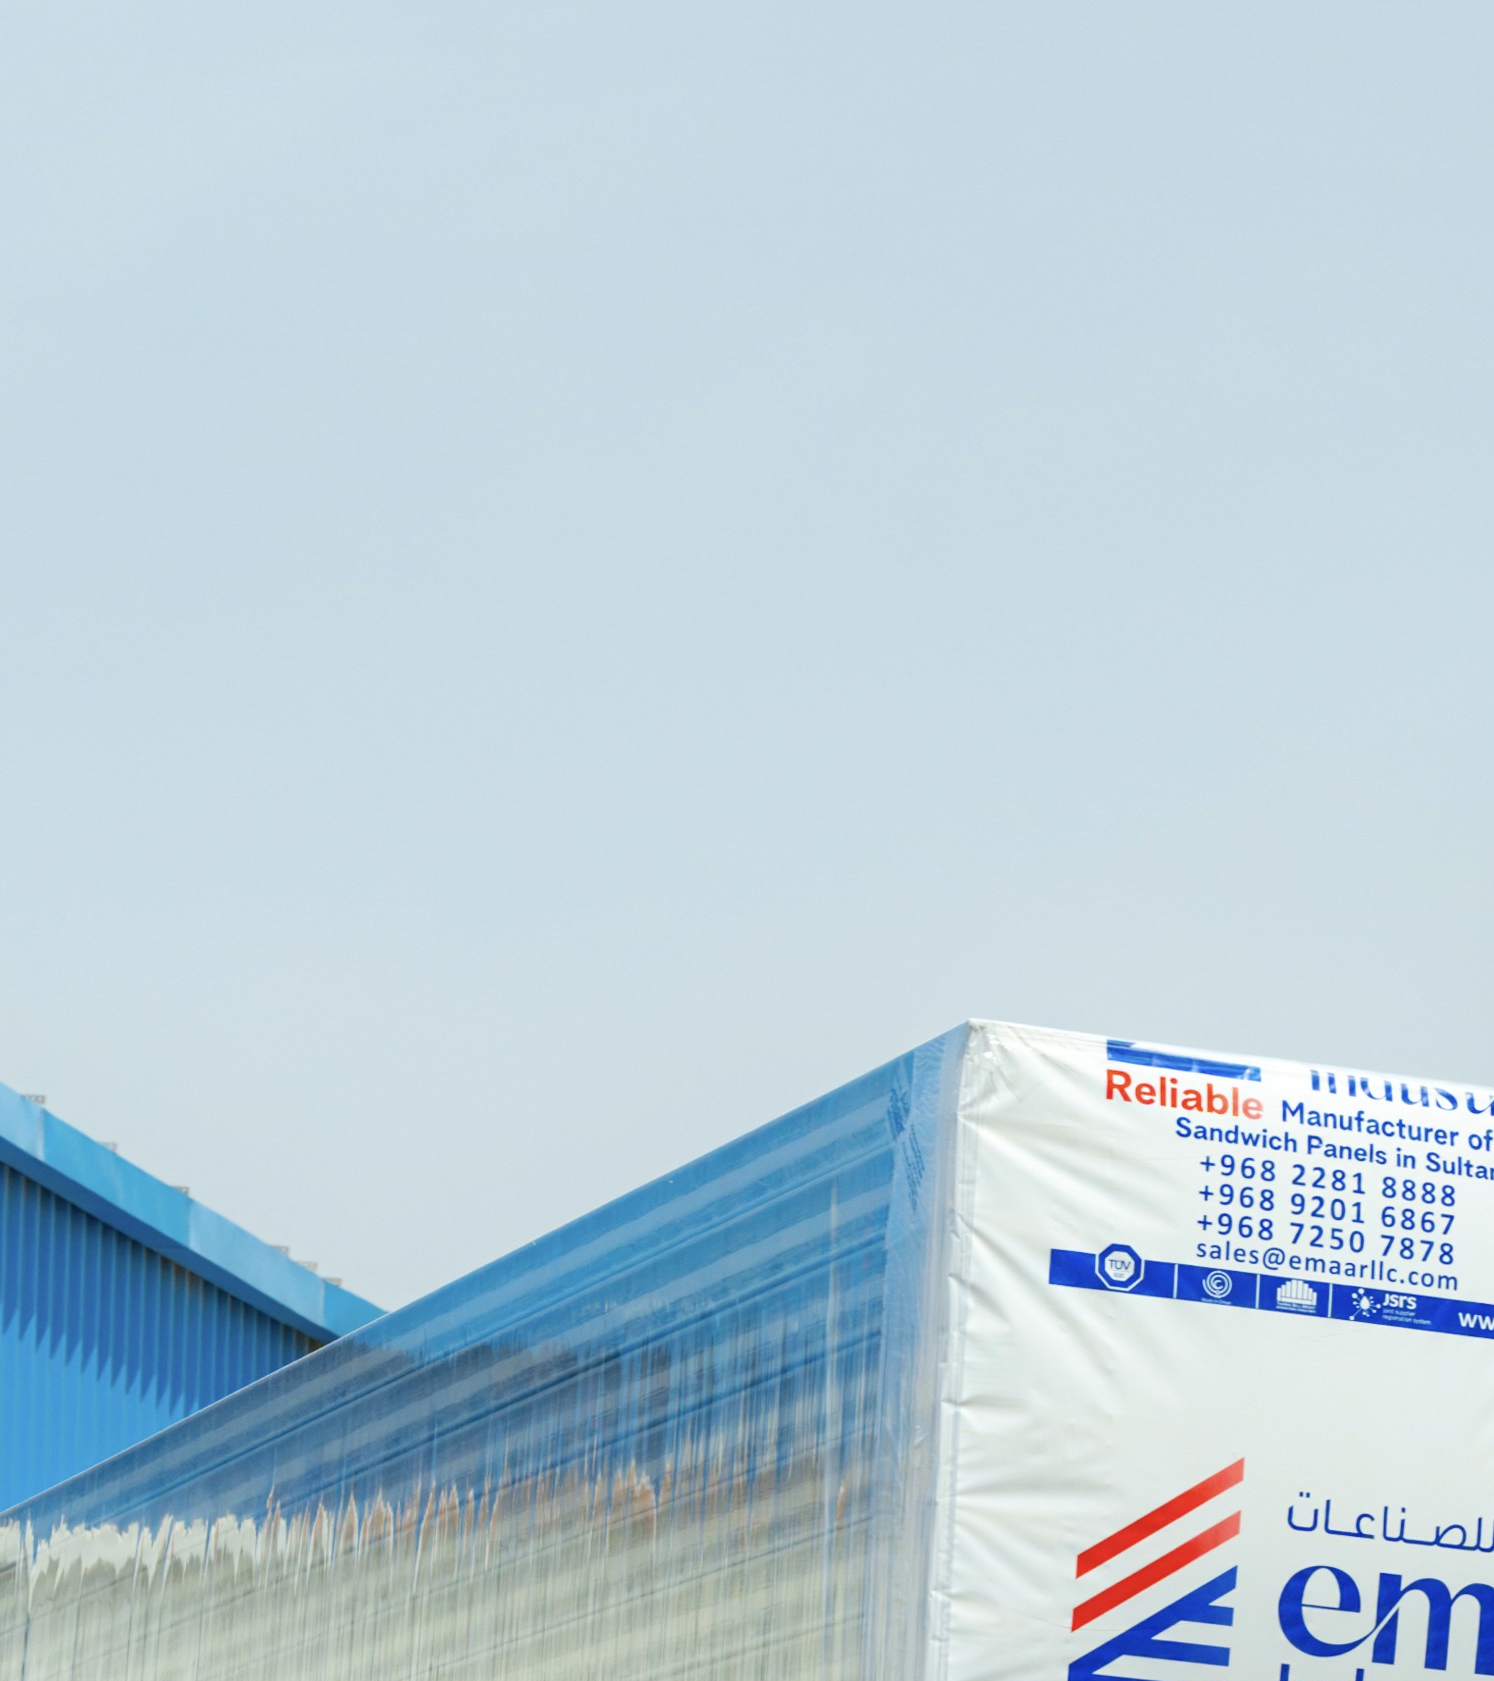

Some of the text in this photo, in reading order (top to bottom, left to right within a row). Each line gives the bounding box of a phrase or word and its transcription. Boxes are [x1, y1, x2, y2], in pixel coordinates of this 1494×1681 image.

[1103, 1067, 1263, 1121] Reliable
[1281, 1098, 1459, 1146] Manufacturer
[1467, 1128, 1494, 1152] of
[1174, 1115, 1297, 1153] Sandwich
[1306, 1133, 1388, 1165] Panels
[1395, 1146, 1416, 1169] in
[1198, 1153, 1455, 1207] +968 2281 8888
[1197, 1183, 1454, 1236] +968 9201 6867
[1195, 1239, 1458, 1291] sales@emaarllc.com
[1196, 1212, 1453, 1266] +968 7250 7878
